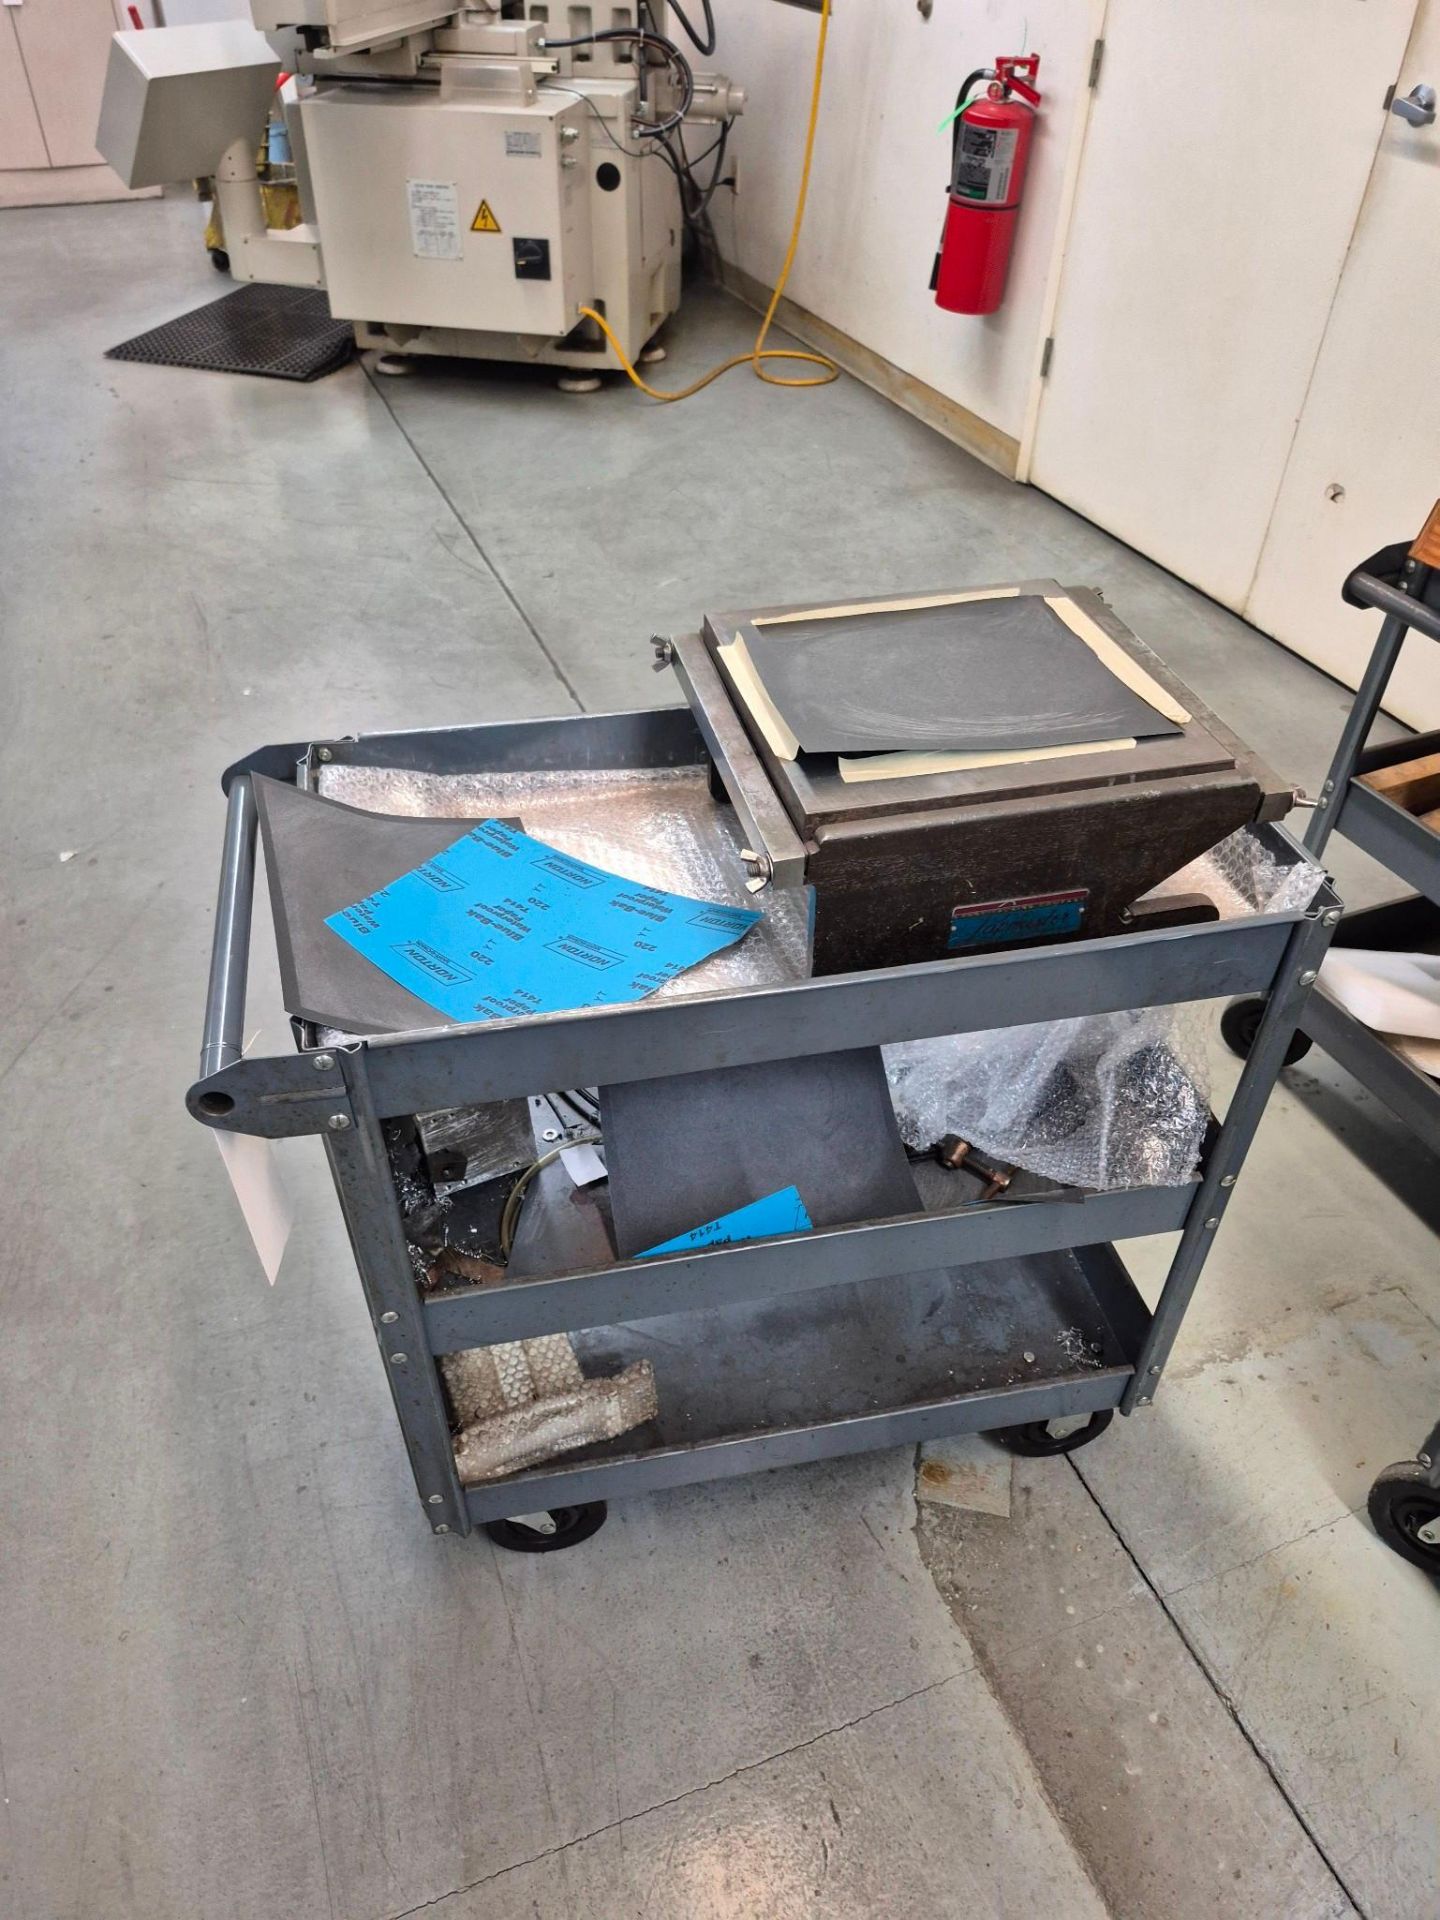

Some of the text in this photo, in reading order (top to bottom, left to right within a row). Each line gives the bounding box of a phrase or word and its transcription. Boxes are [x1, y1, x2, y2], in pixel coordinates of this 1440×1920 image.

[544, 862, 593, 885] NORTON
[493, 905, 524, 921] Paper
[503, 898, 530, 913] T414
[527, 897, 551, 910] 220
[609, 900, 667, 922] Blue-Bak
[616, 893, 674, 914] Waterproof
[466, 909, 525, 941] Blue-Bak
[473, 903, 532, 933] Waterproof
[557, 943, 610, 965] NORTON
[634, 940, 658, 952] 220
[404, 949, 458, 980] NORTON
[470, 951, 494, 965] 220
[514, 989, 542, 1003] T414
[690, 1221, 722, 1240] T414
